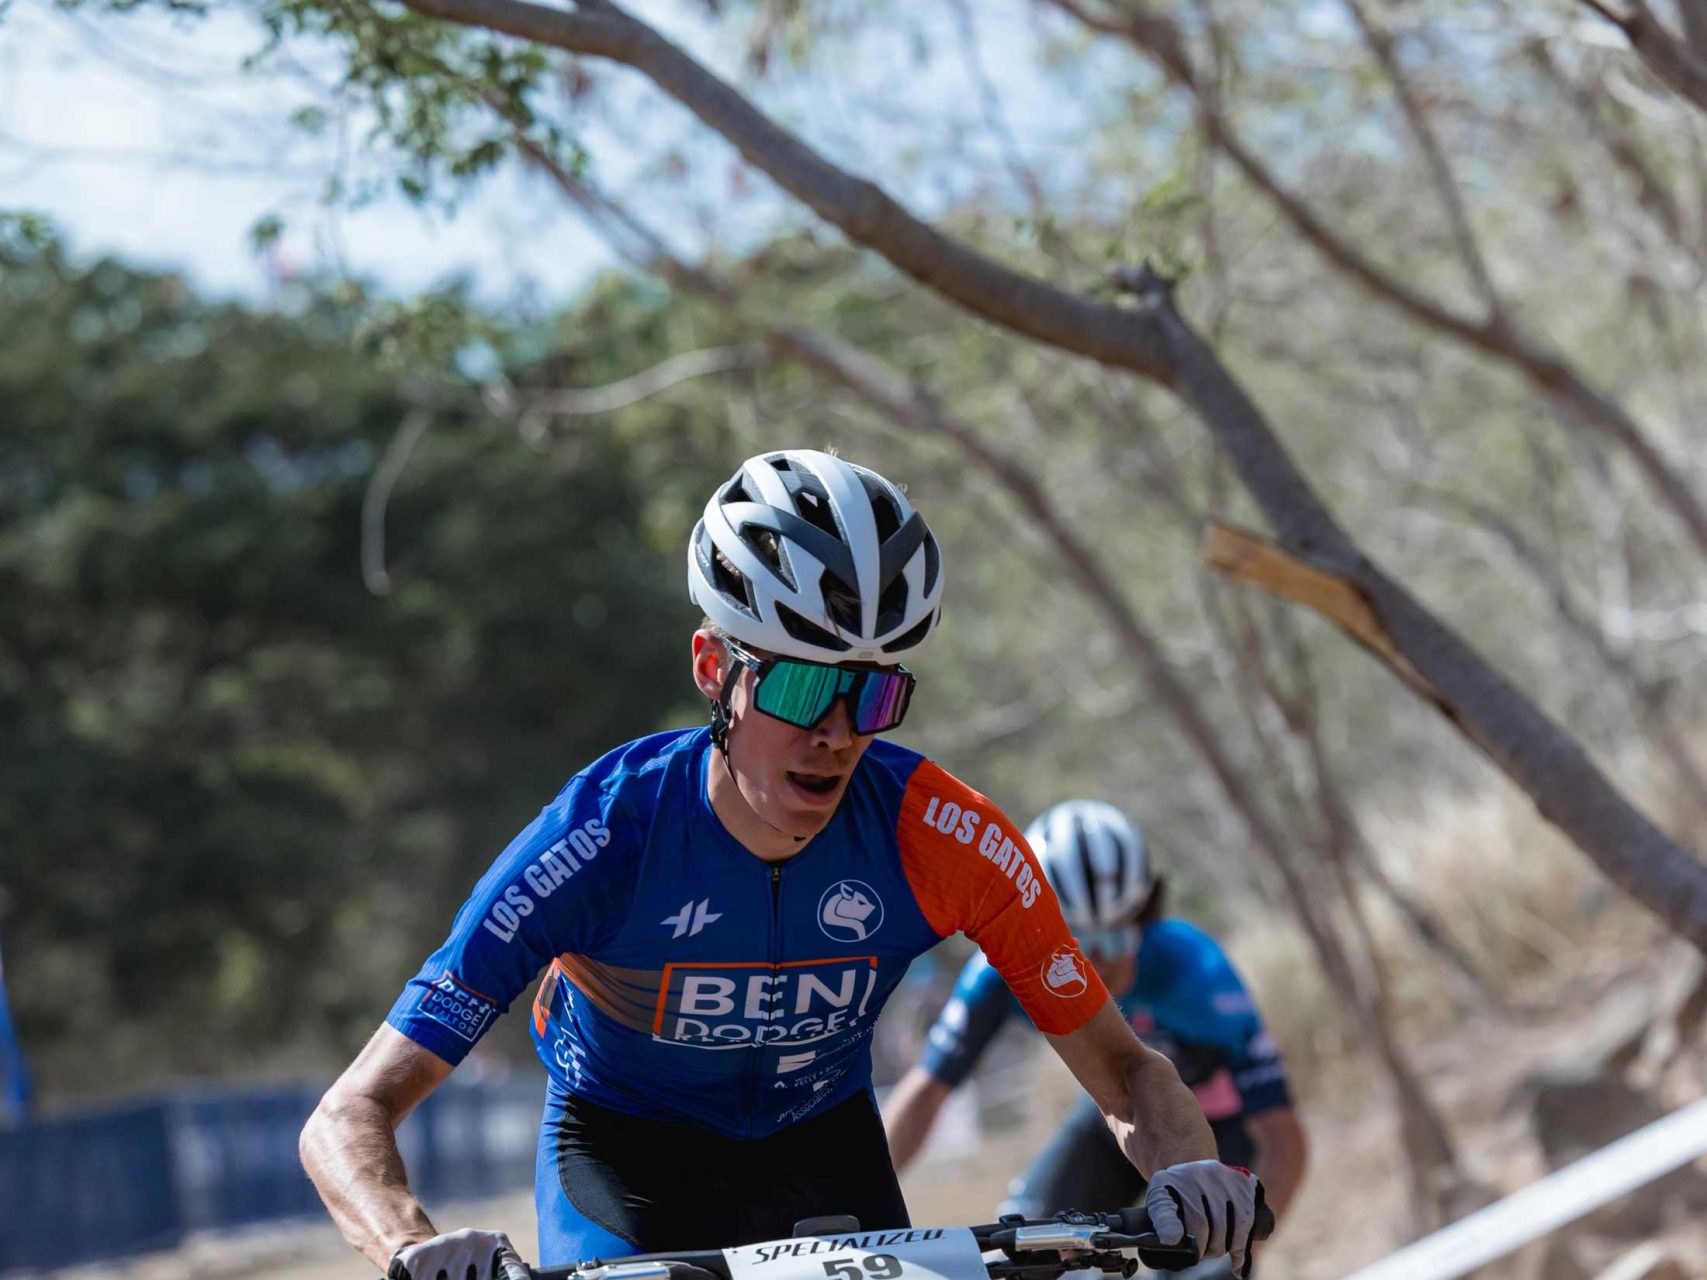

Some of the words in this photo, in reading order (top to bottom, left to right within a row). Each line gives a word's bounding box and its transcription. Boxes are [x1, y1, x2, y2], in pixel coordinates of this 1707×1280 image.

[923, 796, 980, 845] LOS
[978, 823, 1042, 910] GATOS
[482, 884, 535, 944] LOS
[523, 818, 611, 898] GATOS
[431, 990, 482, 1027] DODGE
[678, 969, 857, 1021] BEN
[751, 1228, 946, 1265] SPECIALIZED
